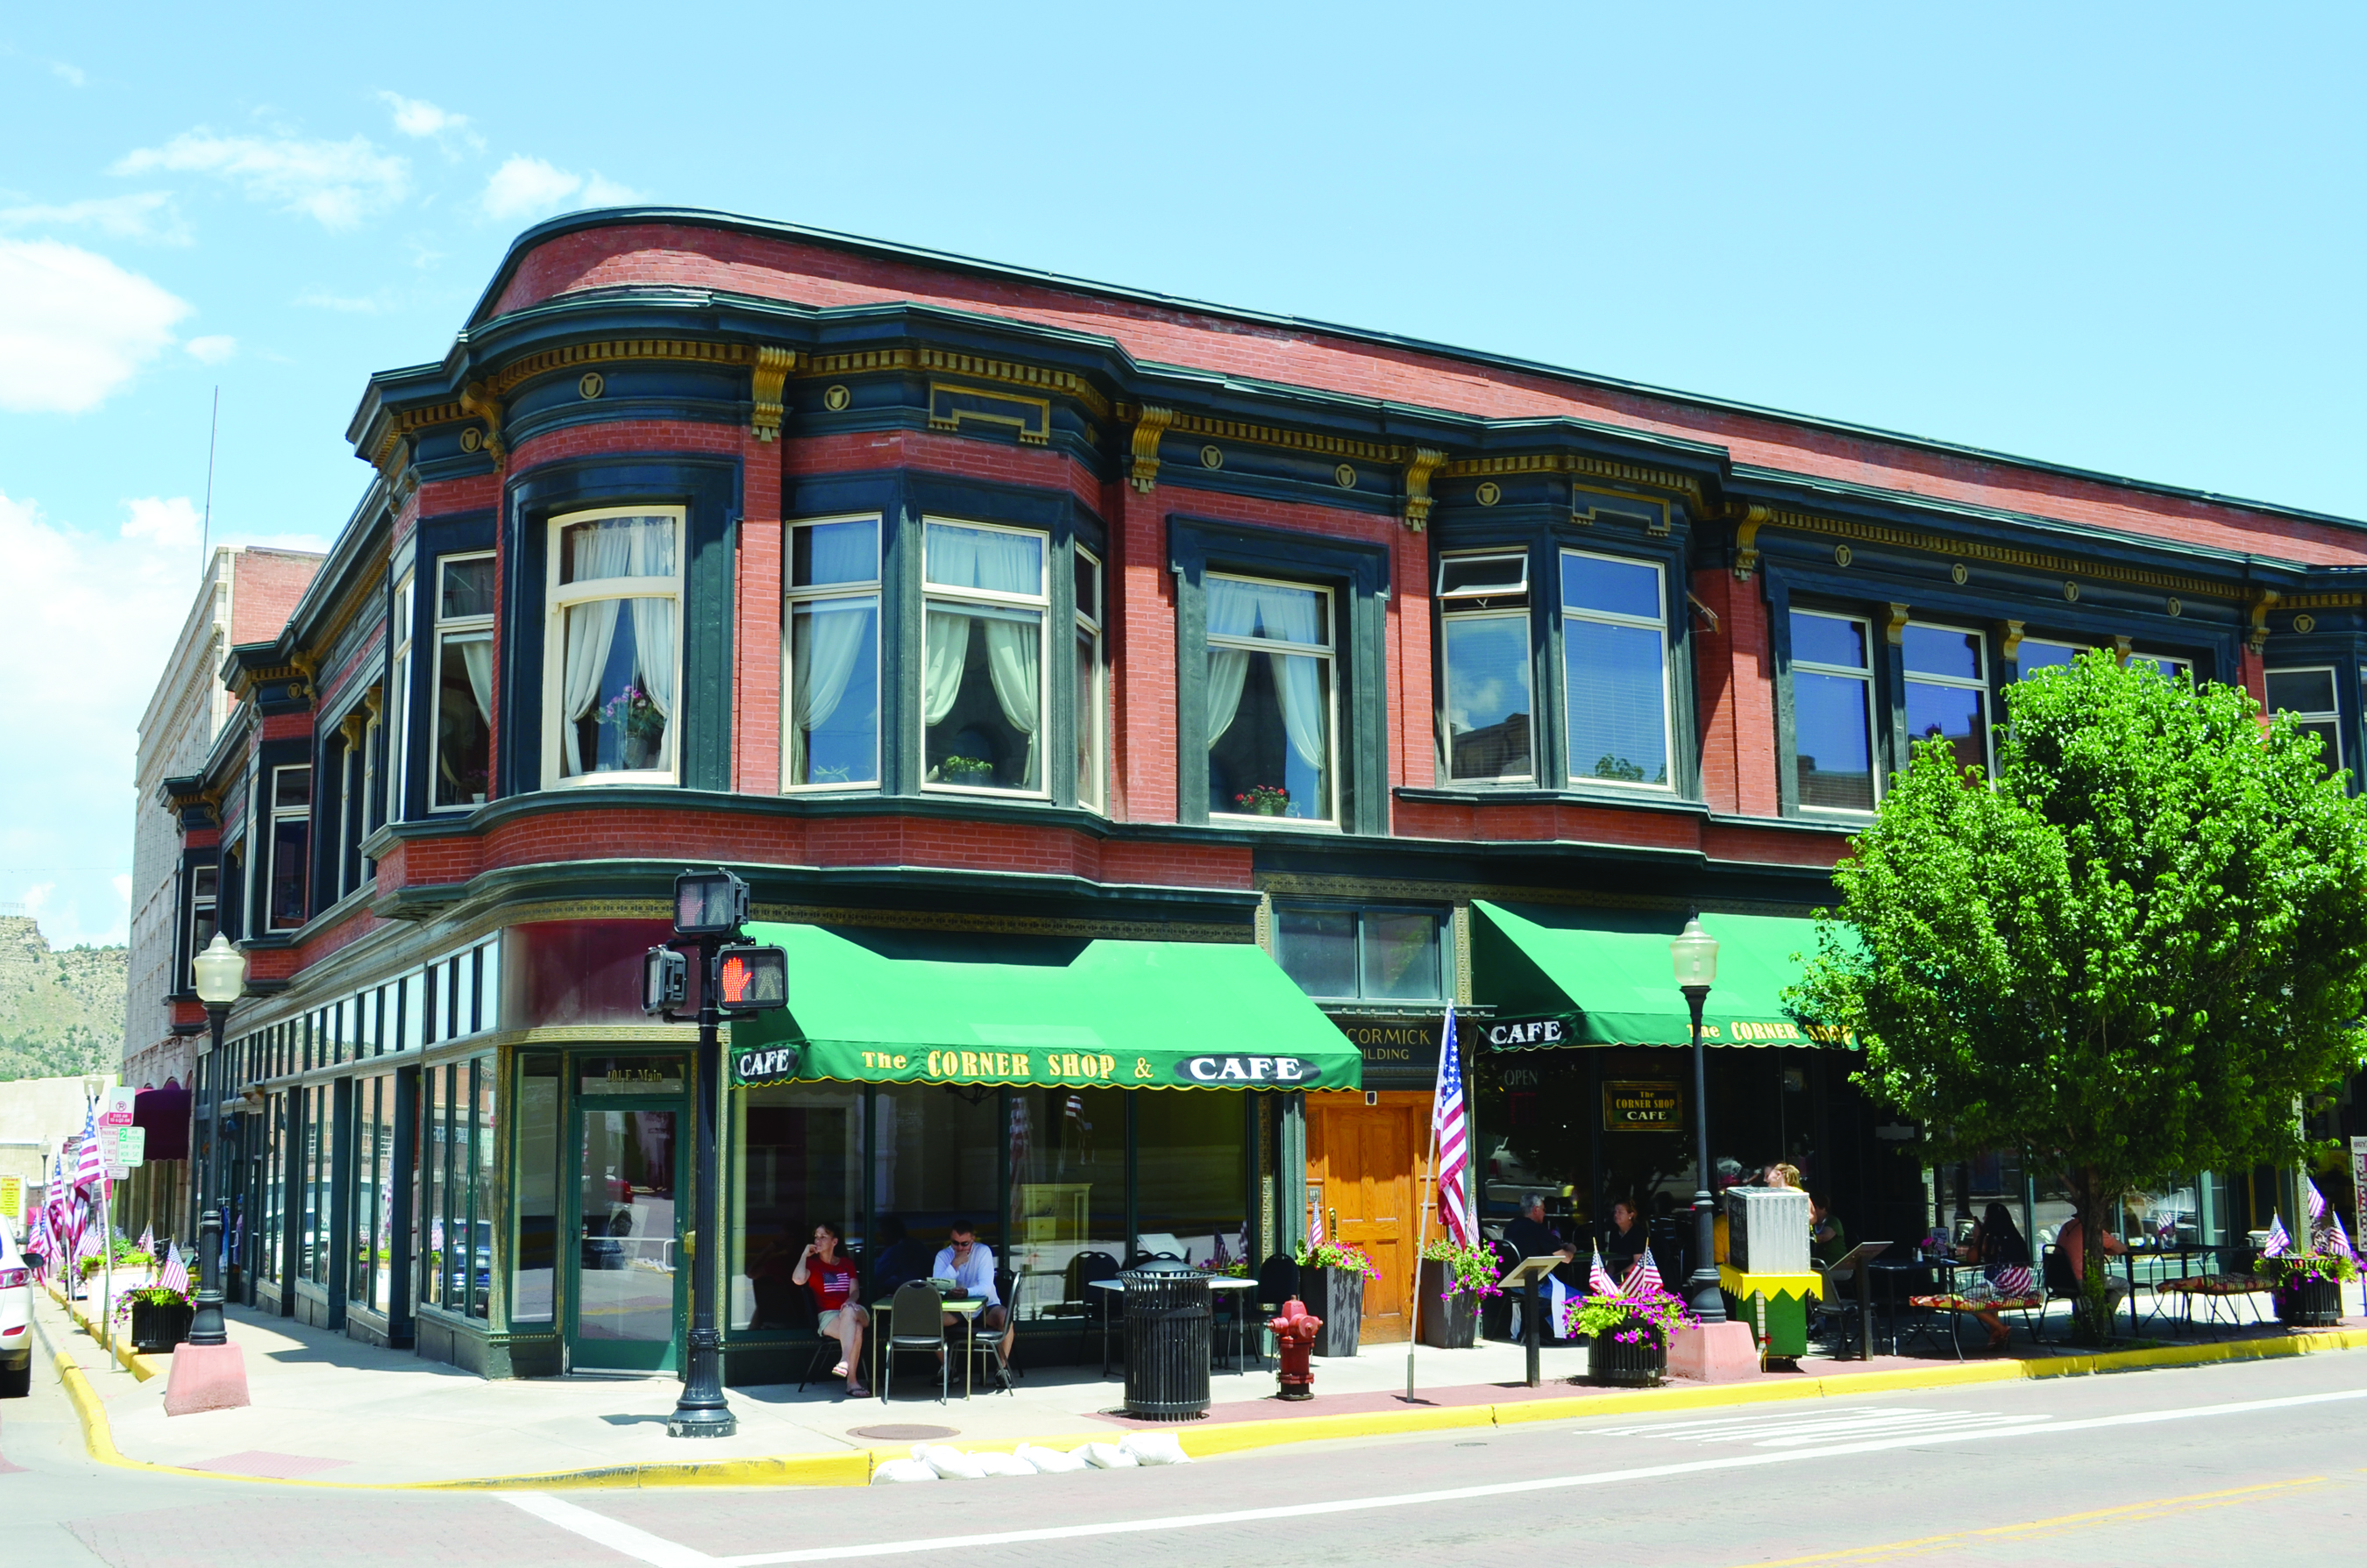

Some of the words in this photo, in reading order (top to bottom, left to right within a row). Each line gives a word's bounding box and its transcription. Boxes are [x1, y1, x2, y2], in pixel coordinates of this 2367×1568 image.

[1346, 1028, 1431, 1045] CORMICK
[1490, 1021, 1561, 1044] CAFE
[1731, 1021, 1800, 1041] CORNER
[1360, 1048, 1410, 1060] ILDING
[739, 1049, 789, 1077] CAFE
[862, 1051, 906, 1069] The
[928, 1050, 1030, 1077] CORNER
[1048, 1053, 1115, 1079] SHOP
[1134, 1057, 1154, 1079] &
[1190, 1057, 1304, 1081] CAFE
[608, 1069, 622, 1082] 101
[638, 1069, 663, 1082] Main
[1504, 1069, 1538, 1086] OPEN
[1616, 1098, 1651, 1109] CORNER
[1653, 1098, 1674, 1109] SHOP
[1626, 1111, 1667, 1120] CAFE
[120, 1130, 126, 1140] 2
